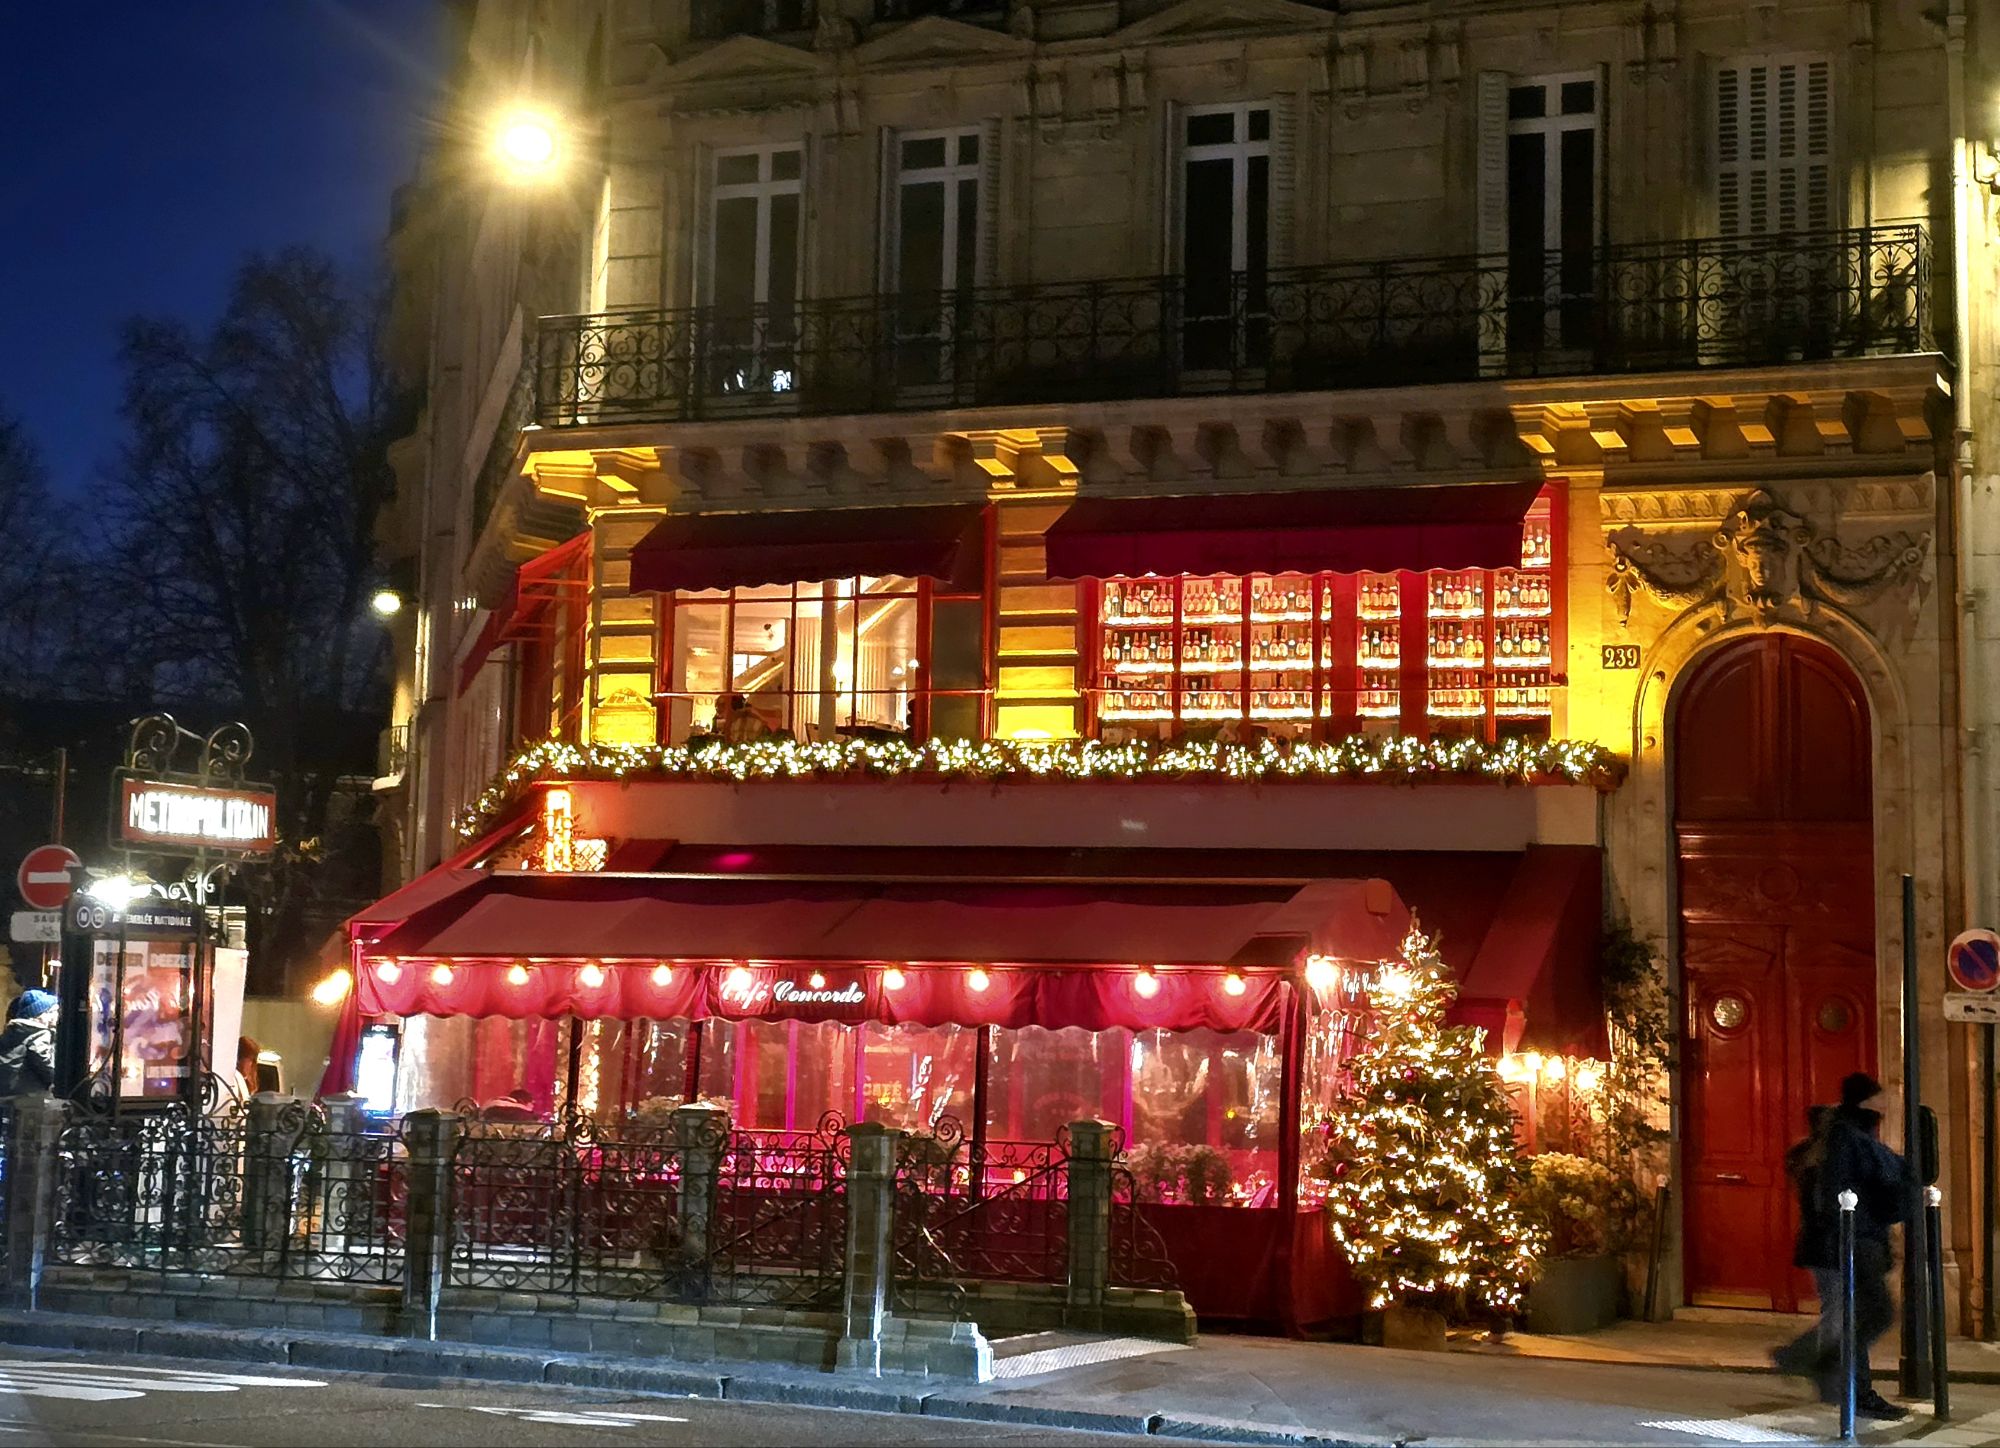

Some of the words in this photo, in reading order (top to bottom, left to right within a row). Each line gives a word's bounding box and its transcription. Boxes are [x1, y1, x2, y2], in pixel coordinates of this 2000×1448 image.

[1604, 647, 1638, 668] 239
[129, 791, 269, 839] METROPOLITAIN
[720, 980, 768, 1009] Café
[773, 979, 866, 1004] Concorde
